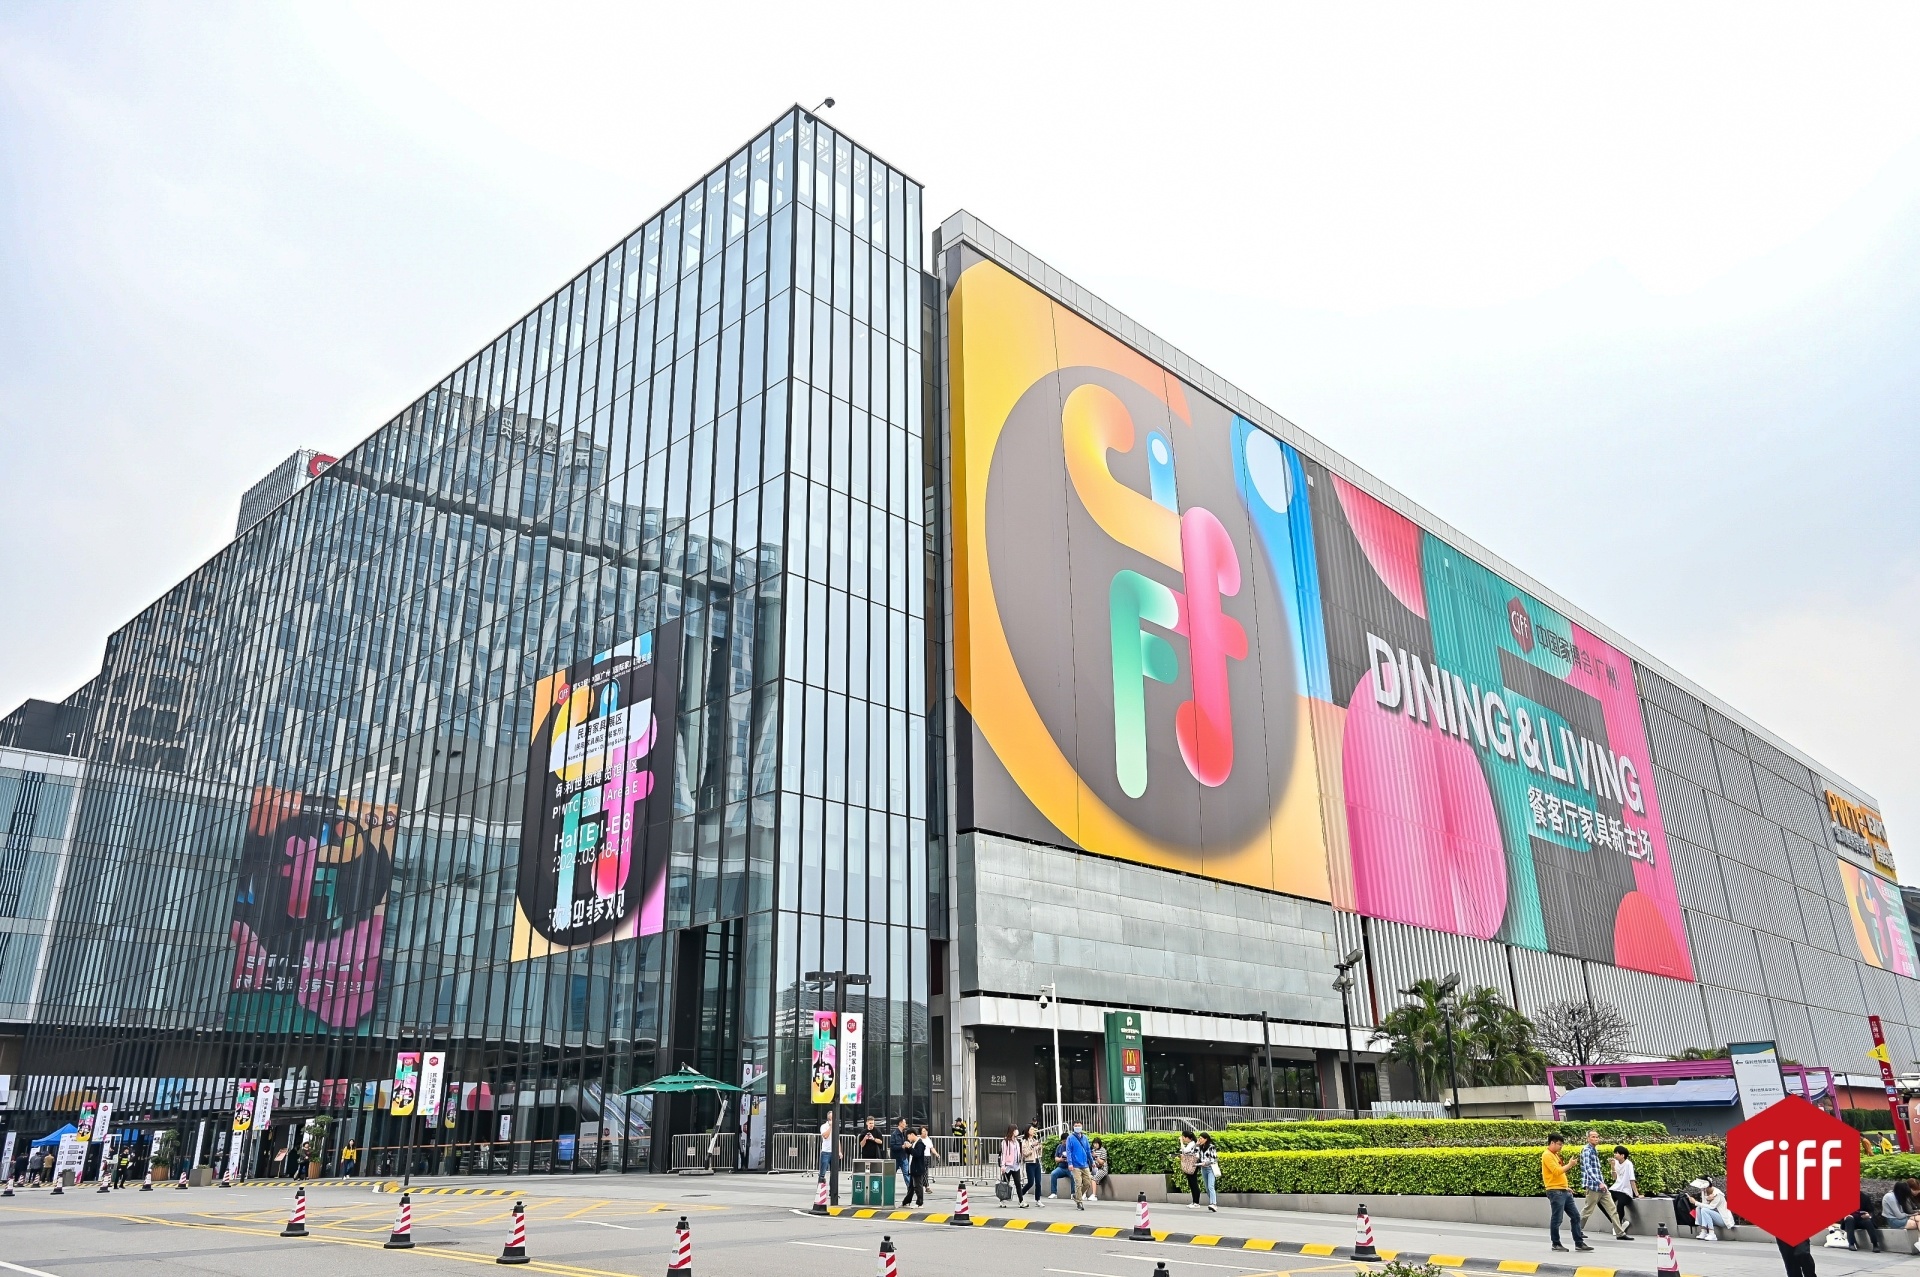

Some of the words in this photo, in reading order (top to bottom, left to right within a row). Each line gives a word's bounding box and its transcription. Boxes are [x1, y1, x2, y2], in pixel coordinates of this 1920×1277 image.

[632, 780, 638, 794] E
[1527, 784, 1655, 865] 餐客厅家具新主场
[548, 889, 626, 933] 欢迎参观
